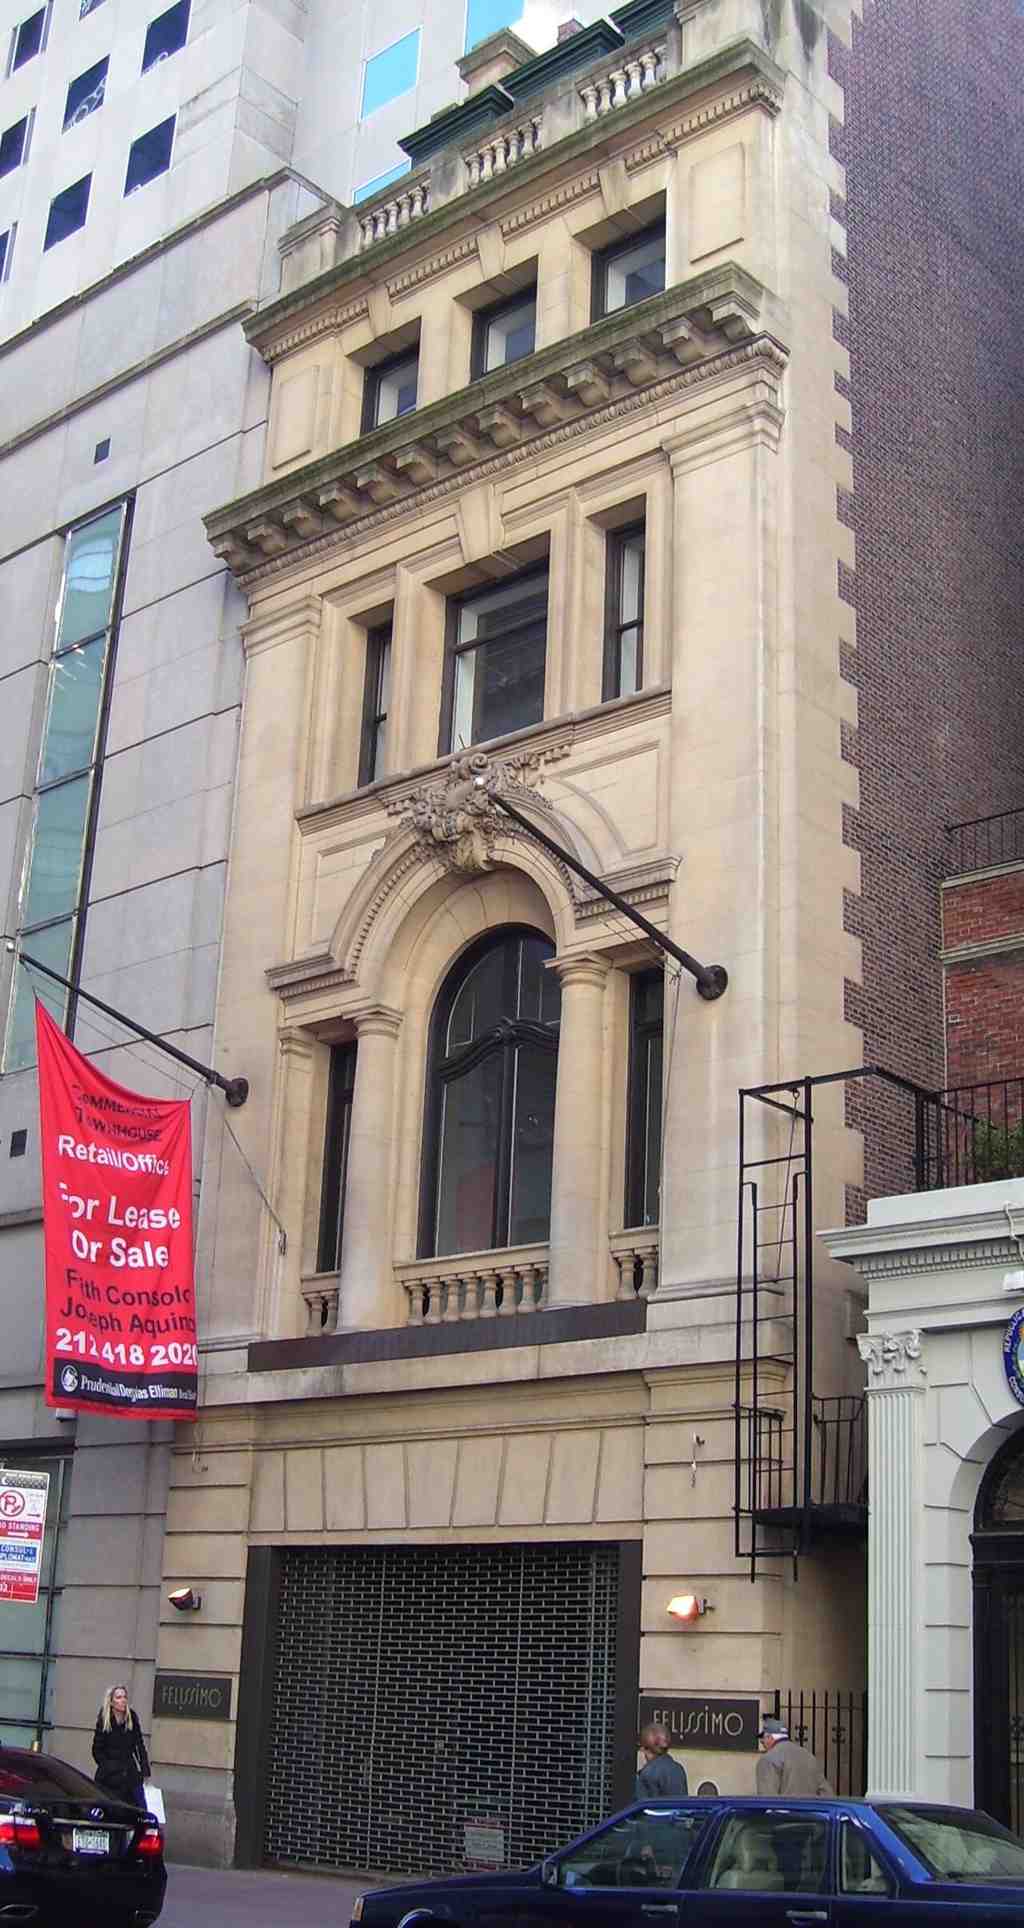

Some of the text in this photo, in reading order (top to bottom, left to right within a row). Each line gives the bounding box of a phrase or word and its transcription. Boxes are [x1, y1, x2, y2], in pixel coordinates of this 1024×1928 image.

[108, 1195, 181, 1229] Lease
[72, 1229, 169, 1268] Or Sale
[101, 1342, 145, 1365] 418
[8, 1521, 40, 1532] STANDING
[161, 1683, 222, 1710] FELISSIMO
[653, 1705, 744, 1740] FELISSIMO
